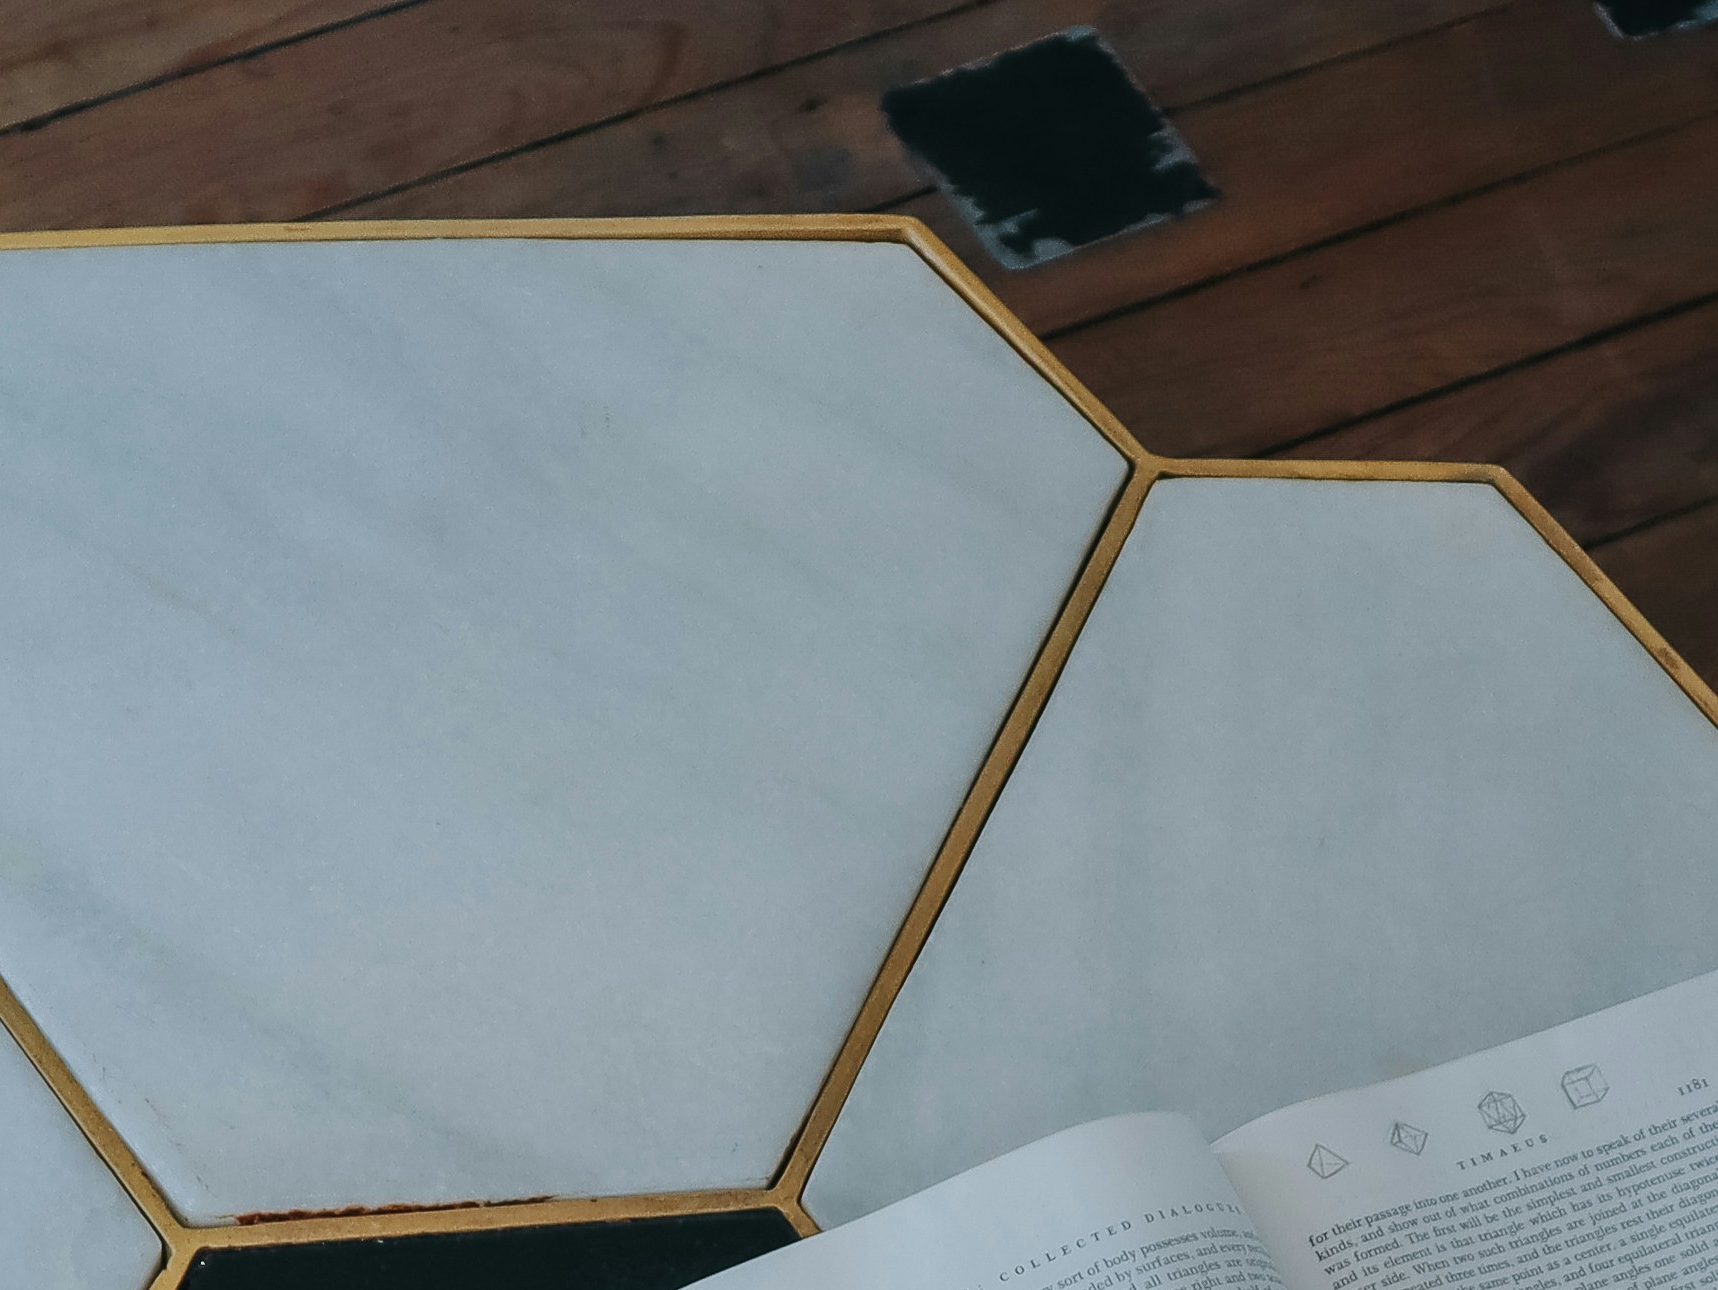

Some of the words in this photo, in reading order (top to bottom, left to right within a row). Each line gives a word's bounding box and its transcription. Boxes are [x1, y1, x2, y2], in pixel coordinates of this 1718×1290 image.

[1456, 1134, 1548, 1170] TIMAEUS
[1677, 1077, 1709, 1096] 1181
[1308, 1230, 1333, 1249] for
[1331, 1218, 1366, 1237] their
[1364, 1204, 1413, 1228] passage
[1412, 1198, 1438, 1210] into
[1438, 1192, 1460, 1204] one
[1461, 1176, 1513, 1198] another.
[1512, 1170, 1521, 1182] I
[1520, 1163, 1552, 1179] have
[1553, 1153, 1579, 1169] now
[1580, 1149, 1595, 1160] to
[1596, 1134, 1632, 1156] speak
[1632, 1128, 1647, 1142] of
[1648, 1119, 1678, 1136] their
[998, 1219, 1132, 1280] COLLECTED
